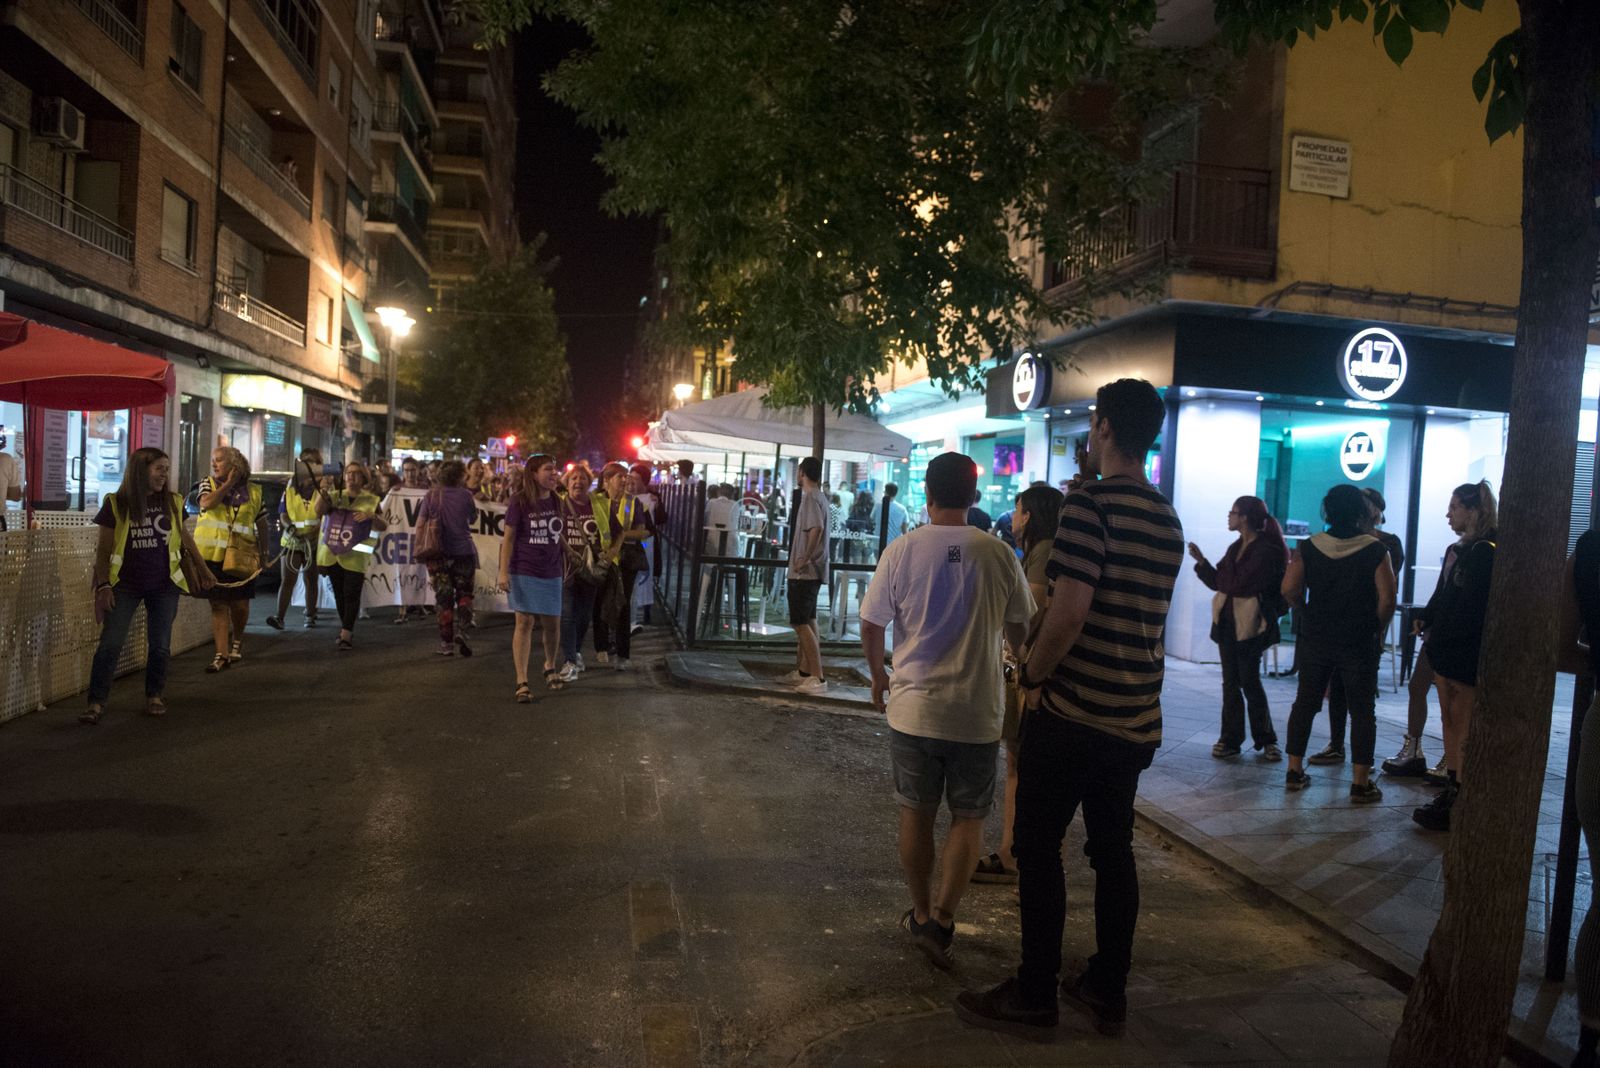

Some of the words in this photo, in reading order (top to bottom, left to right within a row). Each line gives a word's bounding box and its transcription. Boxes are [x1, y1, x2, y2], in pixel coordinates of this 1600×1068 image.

[1297, 141, 1347, 154] PROPIEDAD
[1295, 150, 1348, 163] PARTICULAR
[1358, 340, 1394, 364] 17
[131, 528, 154, 538] PASO
[530, 529, 548, 537] PASO
